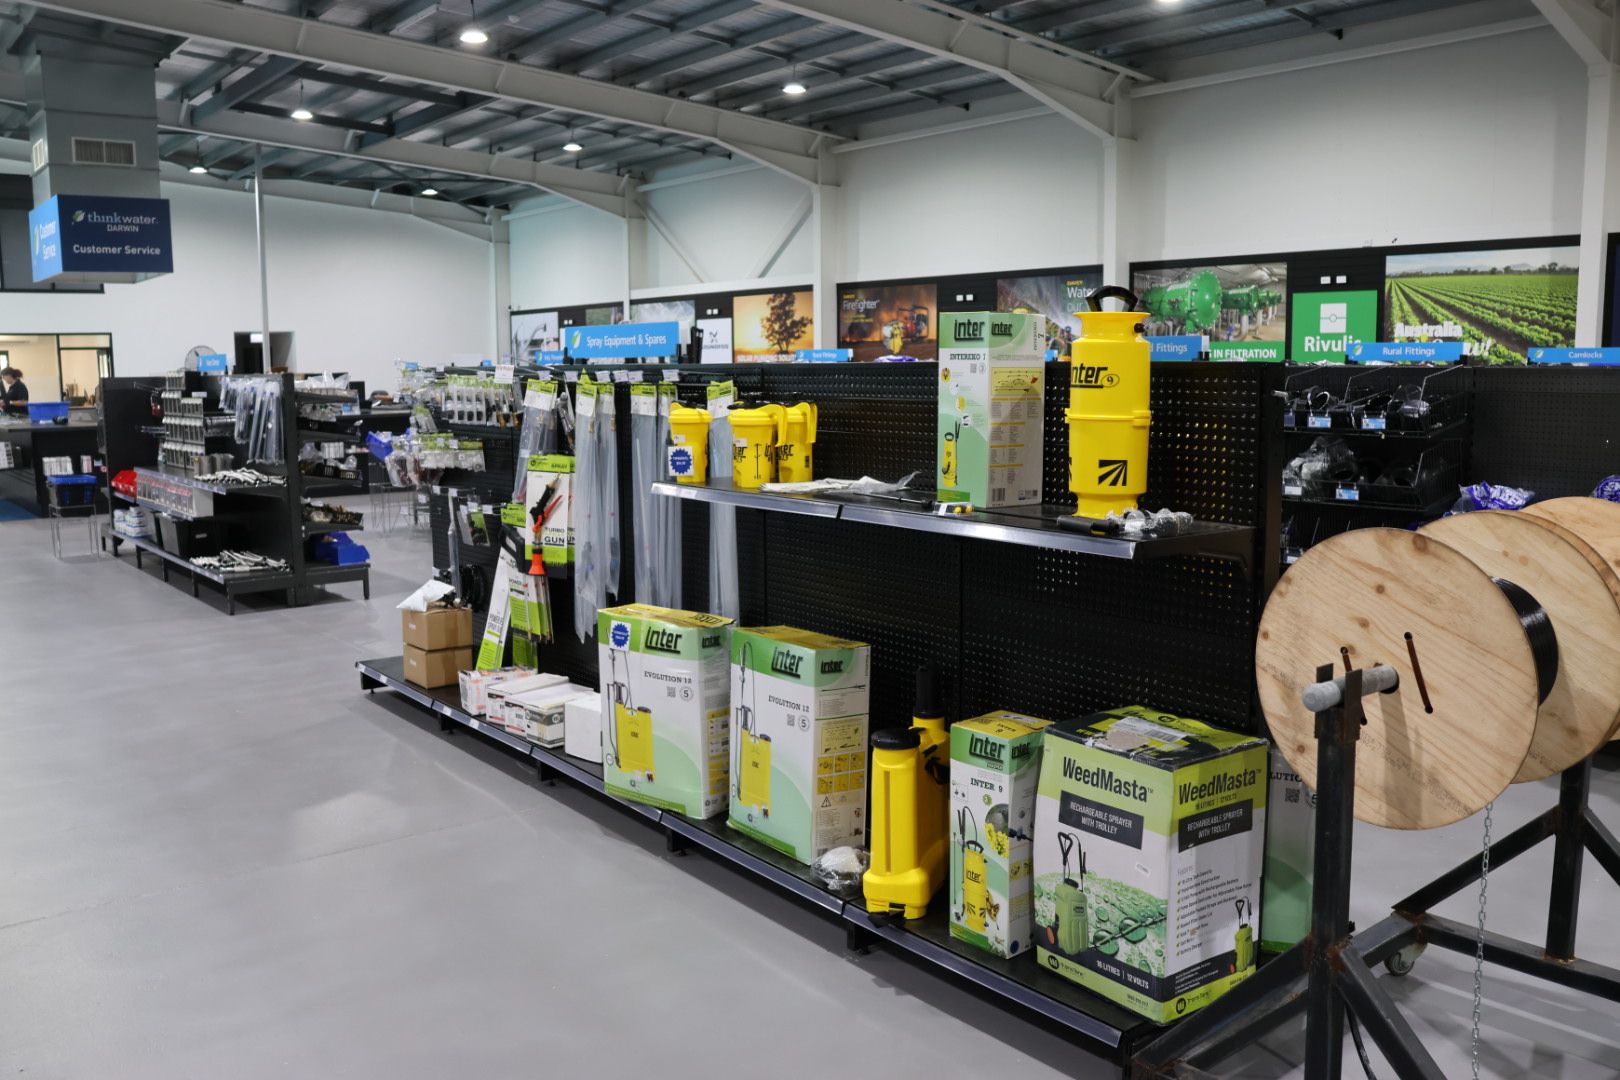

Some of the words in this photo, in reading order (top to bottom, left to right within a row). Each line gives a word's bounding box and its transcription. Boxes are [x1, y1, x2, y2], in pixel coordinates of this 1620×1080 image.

[107, 224, 139, 232] DARWIN
[73, 244, 122, 254] Customer
[124, 245, 160, 255] Service
[1394, 321, 1463, 338] Australia
[586, 336, 603, 349] Spray
[604, 335, 637, 347] Equipment
[638, 335, 644, 344] &
[645, 334, 667, 347] Spares
[1304, 335, 1361, 352] Rivul
[1156, 343, 1188, 355] Fittings
[1213, 350, 1224, 358] IN
[1225, 349, 1277, 358] FILTRATION
[1383, 346, 1402, 355] Rural
[1404, 346, 1436, 357] Fittings
[1071, 363, 1108, 388] nter
[544, 536, 565, 545] GUN
[644, 670, 682, 683] EVOLUTION
[768, 695, 800, 710] EVOLUTION
[970, 778, 995, 791] INTER
[1070, 802, 1108, 822] RECHARGEABLE
[1108, 812, 1132, 829] SPRAYER
[1081, 816, 1094, 828] WITH
[1095, 818, 1118, 835] TROLLEY
[1132, 975, 1150, 990] VOLTS
